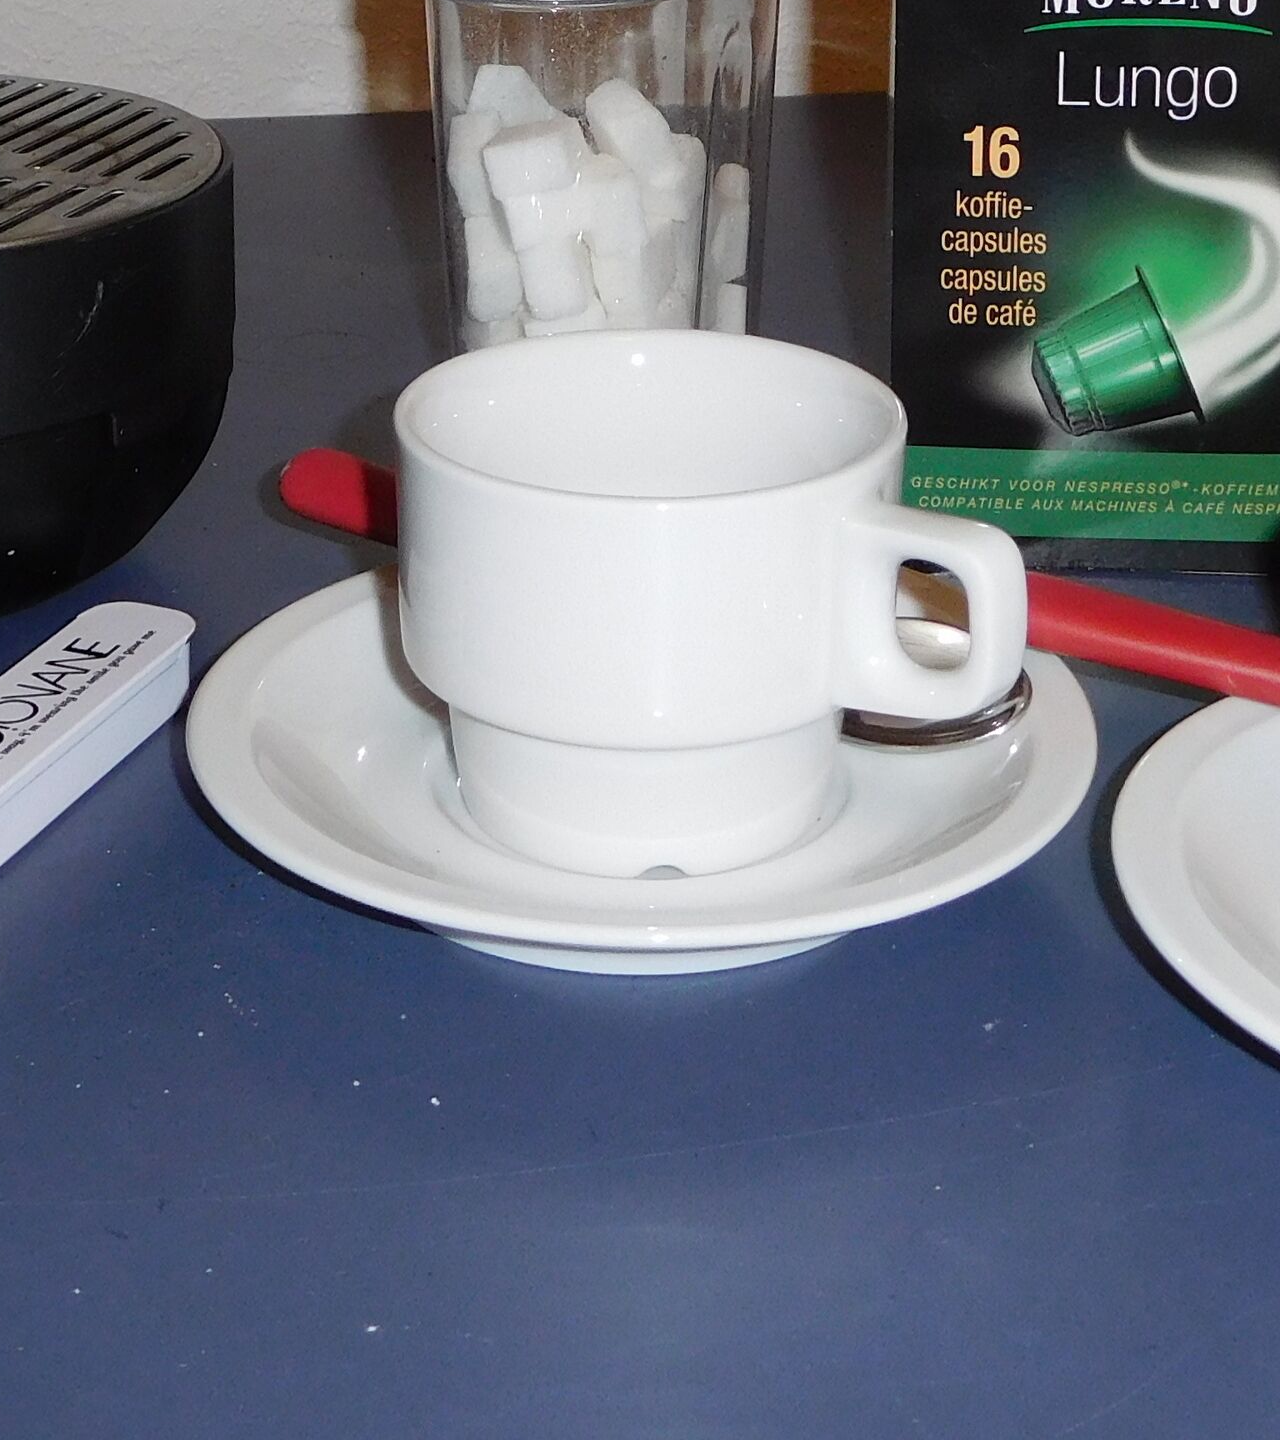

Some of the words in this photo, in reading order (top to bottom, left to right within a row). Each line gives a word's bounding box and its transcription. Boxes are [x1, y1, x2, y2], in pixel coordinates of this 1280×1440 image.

[1057, 51, 1238, 120] Lungo
[963, 125, 1021, 178] 16
[955, 190, 1034, 220] koffie-
[940, 227, 1048, 256] capsules
[939, 265, 1047, 294] capsules
[948, 299, 978, 325] de
[985, 298, 1037, 327] café
[911, 476, 1000, 491] GESCHIKT
[1009, 479, 1057, 492] VOOR
[918, 495, 1025, 511] COMPATIBLE
[1031, 499, 1064, 512] AUX
[1071, 500, 1158, 513] MACHINES
[1165, 498, 1175, 513] À
[1182, 500, 1225, 515] CAFÉ
